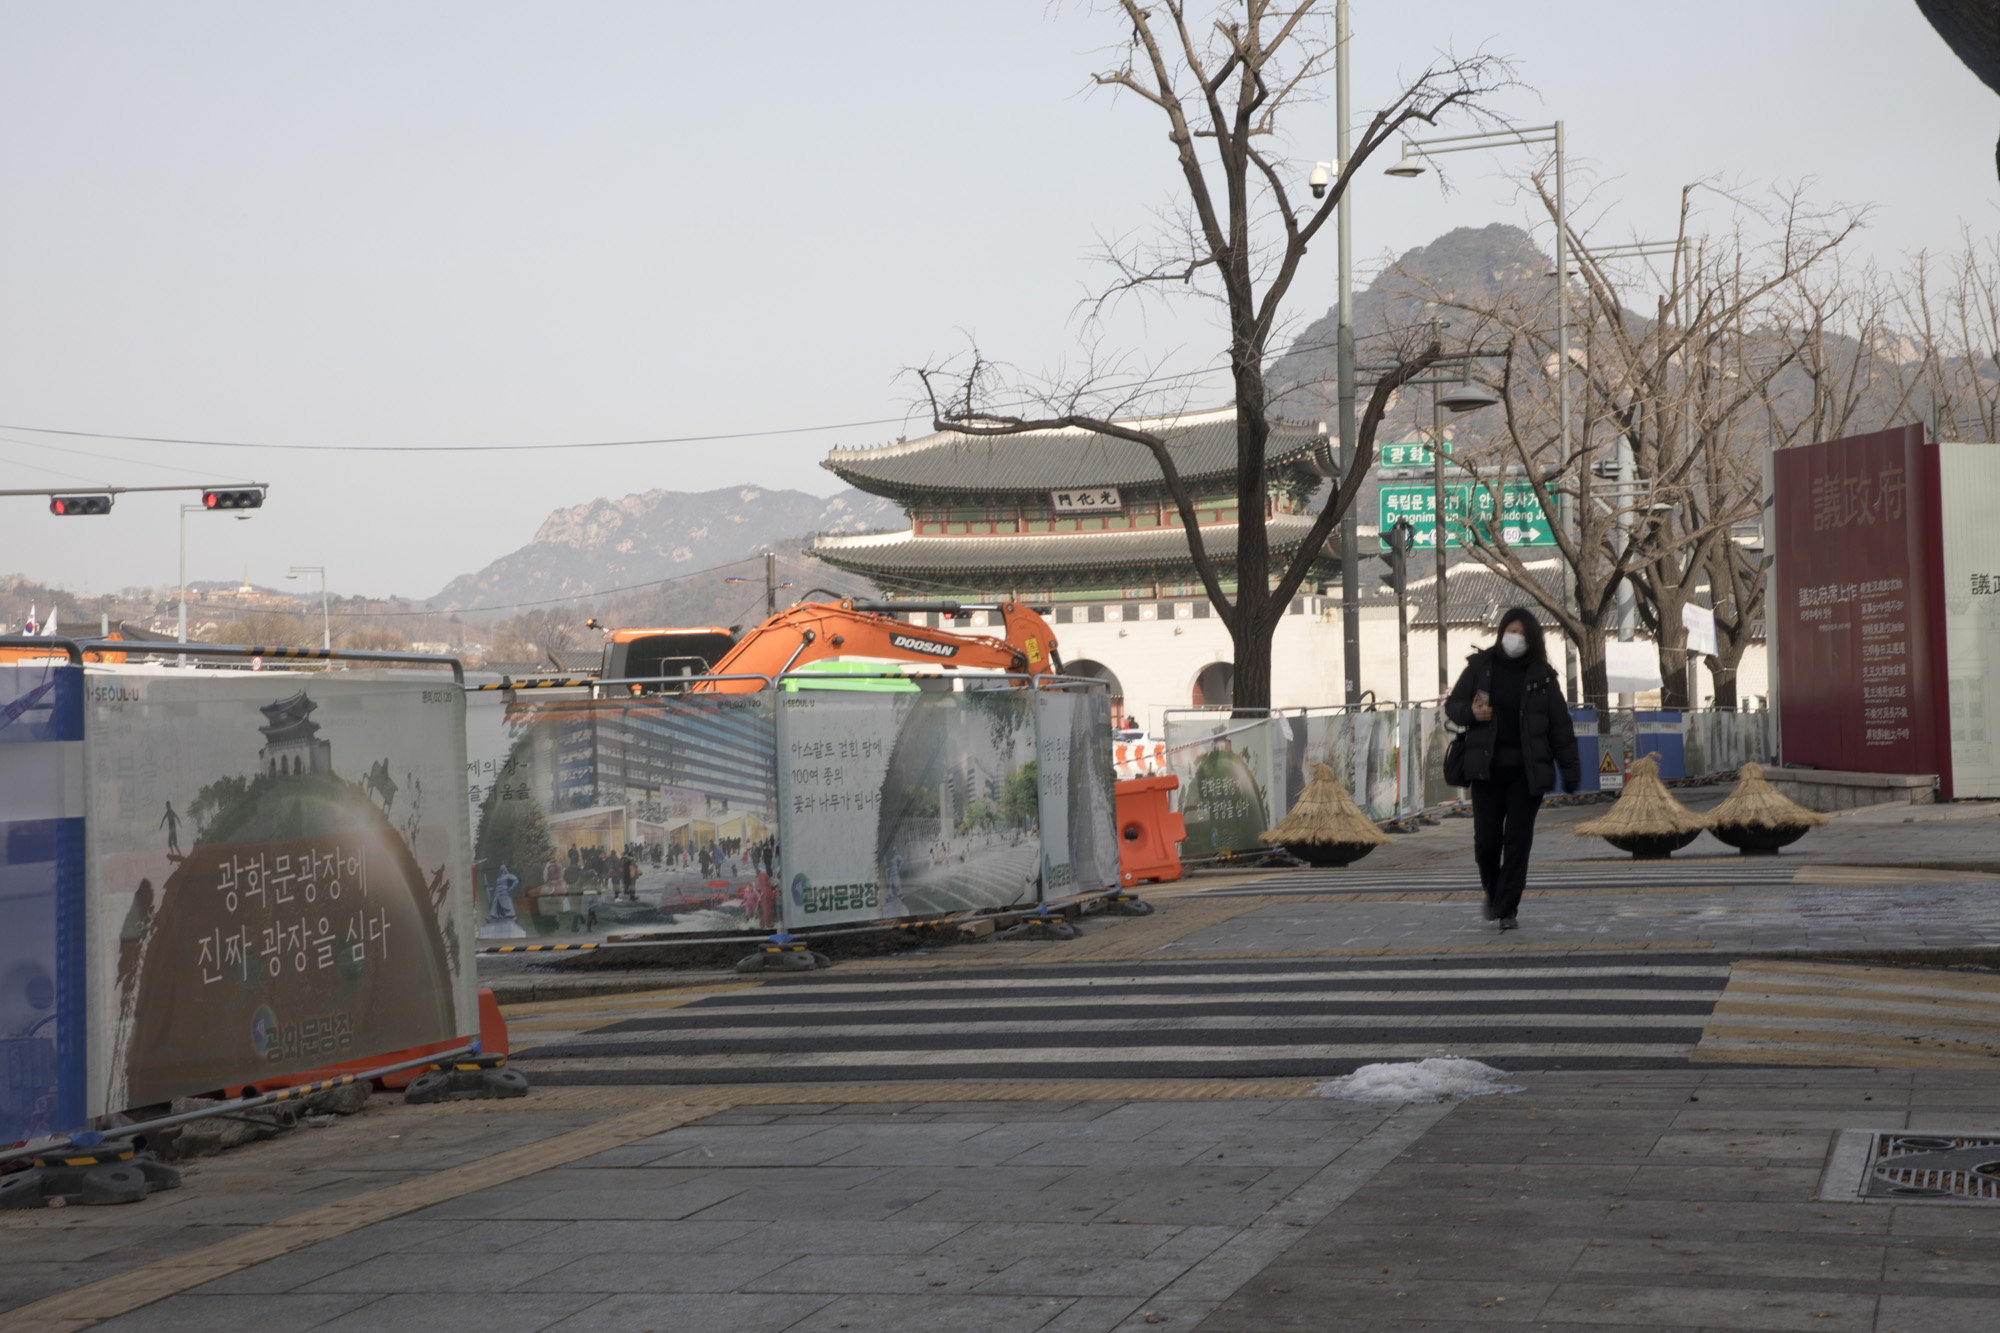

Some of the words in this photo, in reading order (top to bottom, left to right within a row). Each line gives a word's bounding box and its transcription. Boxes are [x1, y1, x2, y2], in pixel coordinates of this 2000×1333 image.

[1386, 494, 1424, 511] 독립문
[1811, 461, 1906, 531] 議政府
[1387, 511, 1460, 525] Dongnimun
[1505, 530, 1518, 541] 50
[894, 635, 953, 656] DOOSAN
[791, 739, 836, 760] 아스팔트
[838, 739, 858, 758] 걷힌
[862, 738, 883, 757] 땅에
[792, 766, 819, 785] 100여
[823, 766, 844, 786] 종의
[468, 782, 531, 802] 즐거움을
[793, 793, 816, 814] 꽃과
[819, 792, 851, 812] 나무가
[217, 845, 367, 912] 광화문광장에
[803, 881, 880, 914] 광화문광장
[198, 923, 252, 985] 진짜
[261, 917, 336, 976] 광장을
[346, 907, 391, 962] 심다
[265, 1013, 353, 1064] 광화문광장
